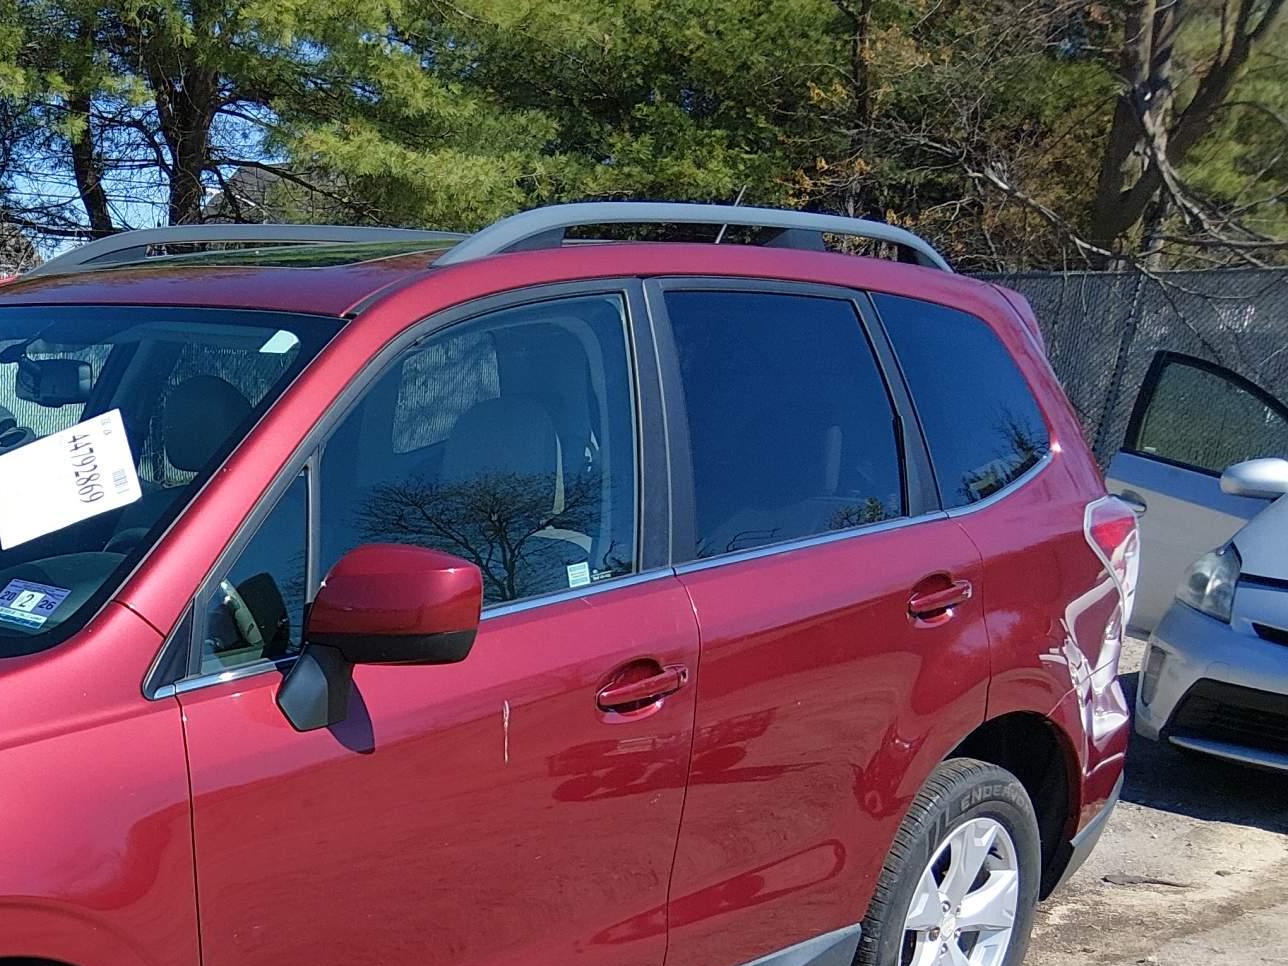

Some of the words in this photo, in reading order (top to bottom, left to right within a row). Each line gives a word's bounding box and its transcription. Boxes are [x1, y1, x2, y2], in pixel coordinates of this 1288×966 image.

[68, 434, 105, 503] 44792869
[0, 590, 17, 601] 20
[18, 593, 35, 608] 2
[37, 599, 57, 610] 26
